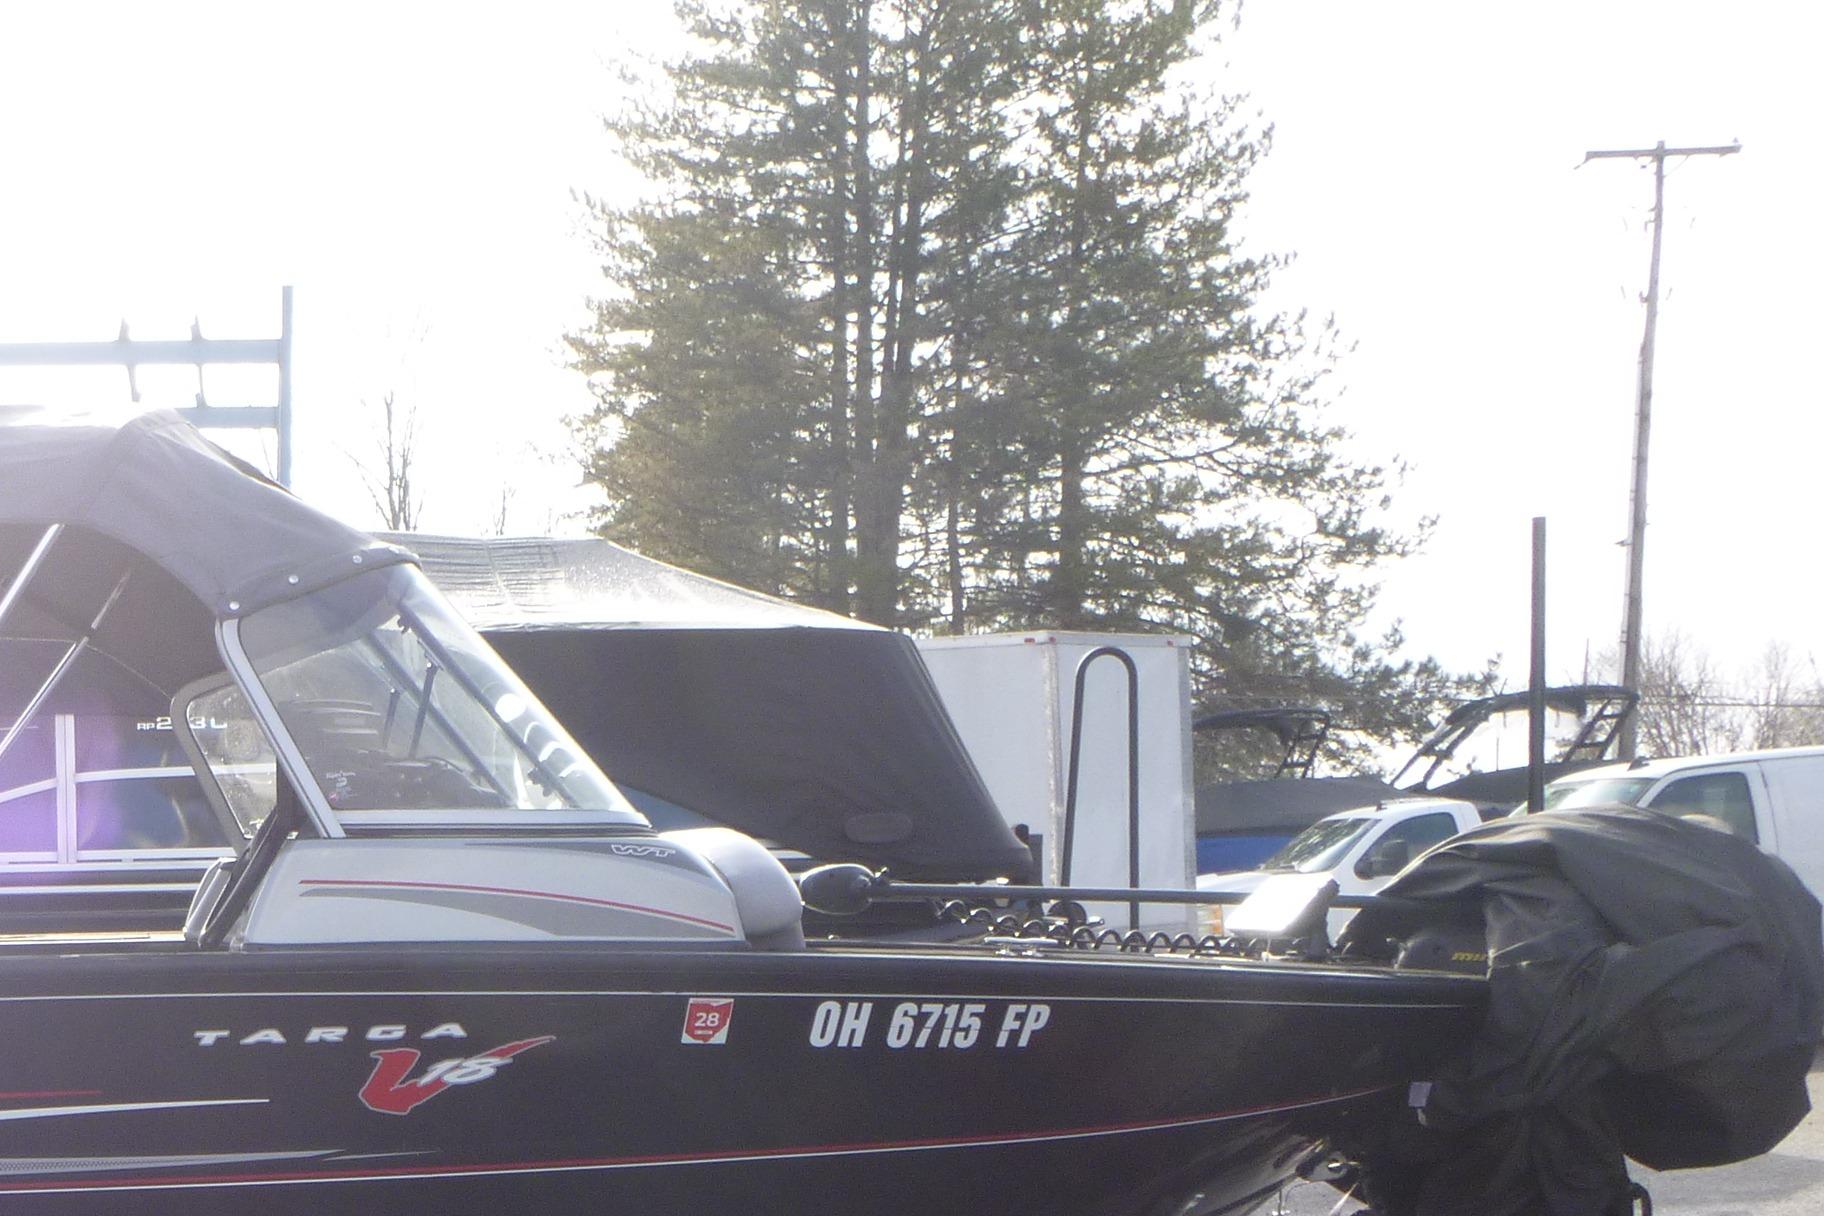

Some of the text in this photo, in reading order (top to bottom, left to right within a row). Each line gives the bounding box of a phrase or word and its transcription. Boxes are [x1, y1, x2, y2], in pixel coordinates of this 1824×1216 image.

[137, 716, 228, 730] RP23L
[611, 844, 675, 858] WT
[694, 1012, 720, 1027] 28
[809, 1001, 1051, 1049] OH 6715 FP
[193, 1022, 468, 1047] TARGA
